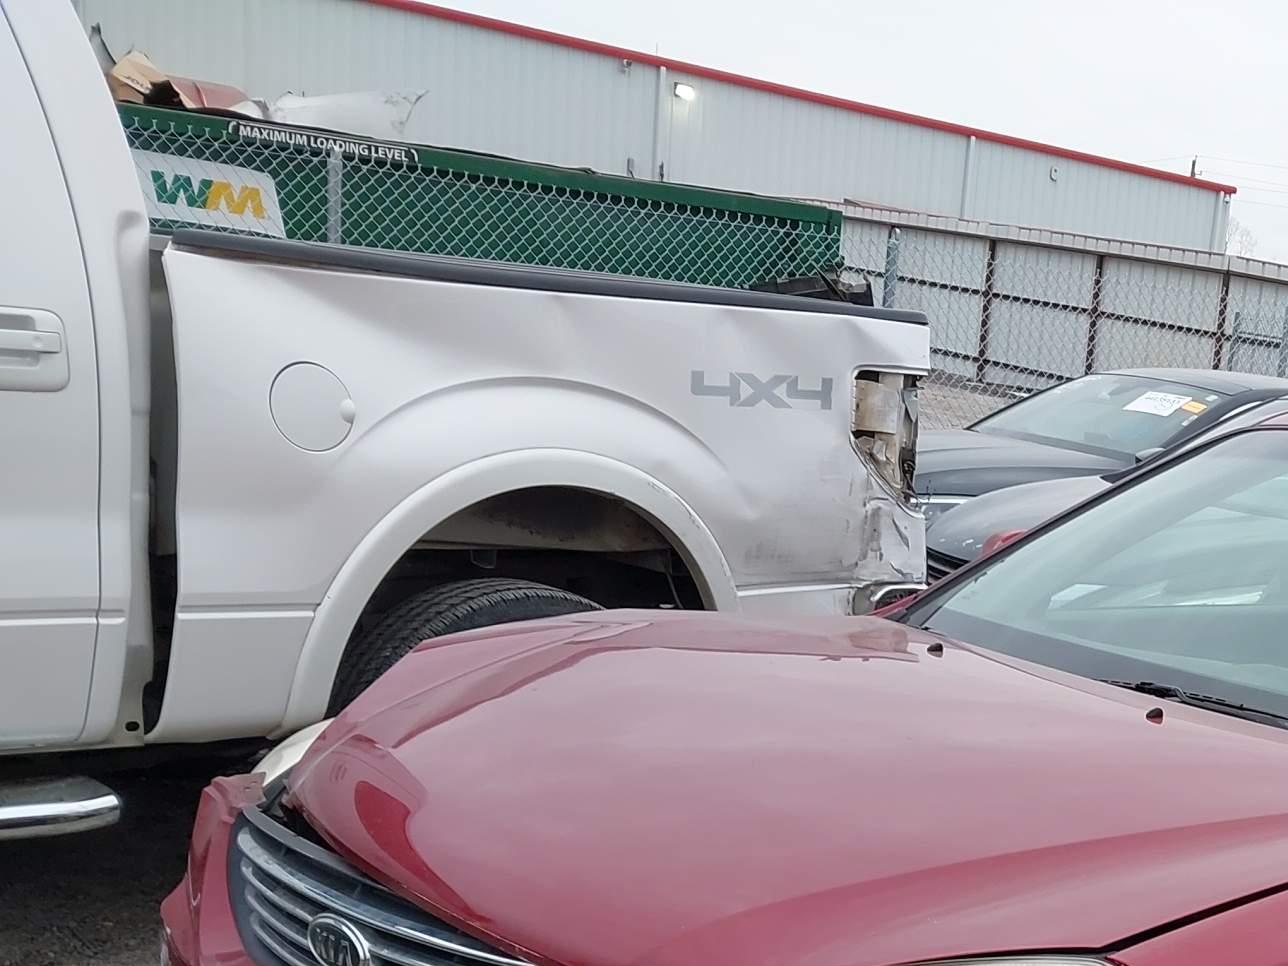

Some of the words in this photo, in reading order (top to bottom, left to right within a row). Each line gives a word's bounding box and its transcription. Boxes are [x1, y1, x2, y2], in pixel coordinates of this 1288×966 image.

[239, 124, 307, 146] MAXIMUM
[310, 137, 368, 155] LOADING
[371, 147, 409, 162] LEVEL
[151, 170, 265, 219] WM
